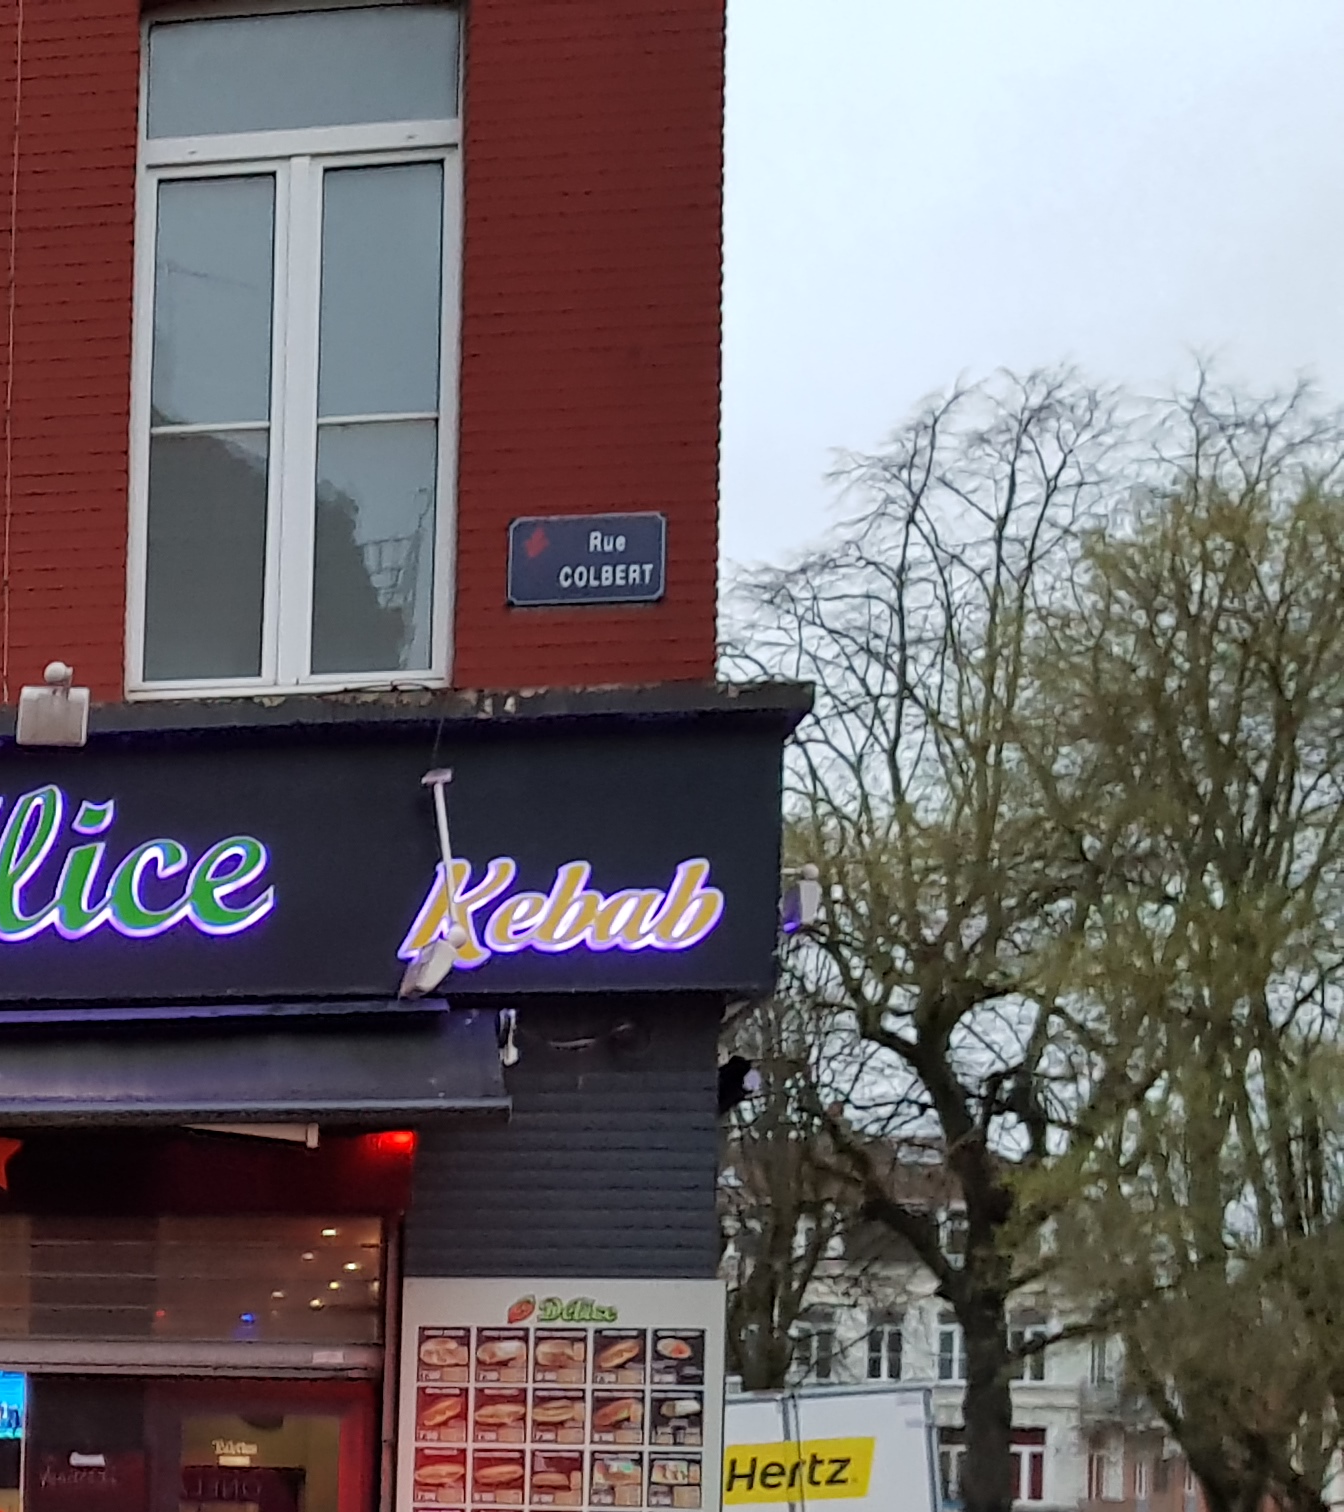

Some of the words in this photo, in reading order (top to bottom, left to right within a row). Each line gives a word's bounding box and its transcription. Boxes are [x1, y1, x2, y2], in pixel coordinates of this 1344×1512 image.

[589, 531, 626, 552] Rue
[559, 563, 654, 588] COLBERT
[396, 855, 724, 970] Kebab
[725, 1453, 851, 1492] Hertz
